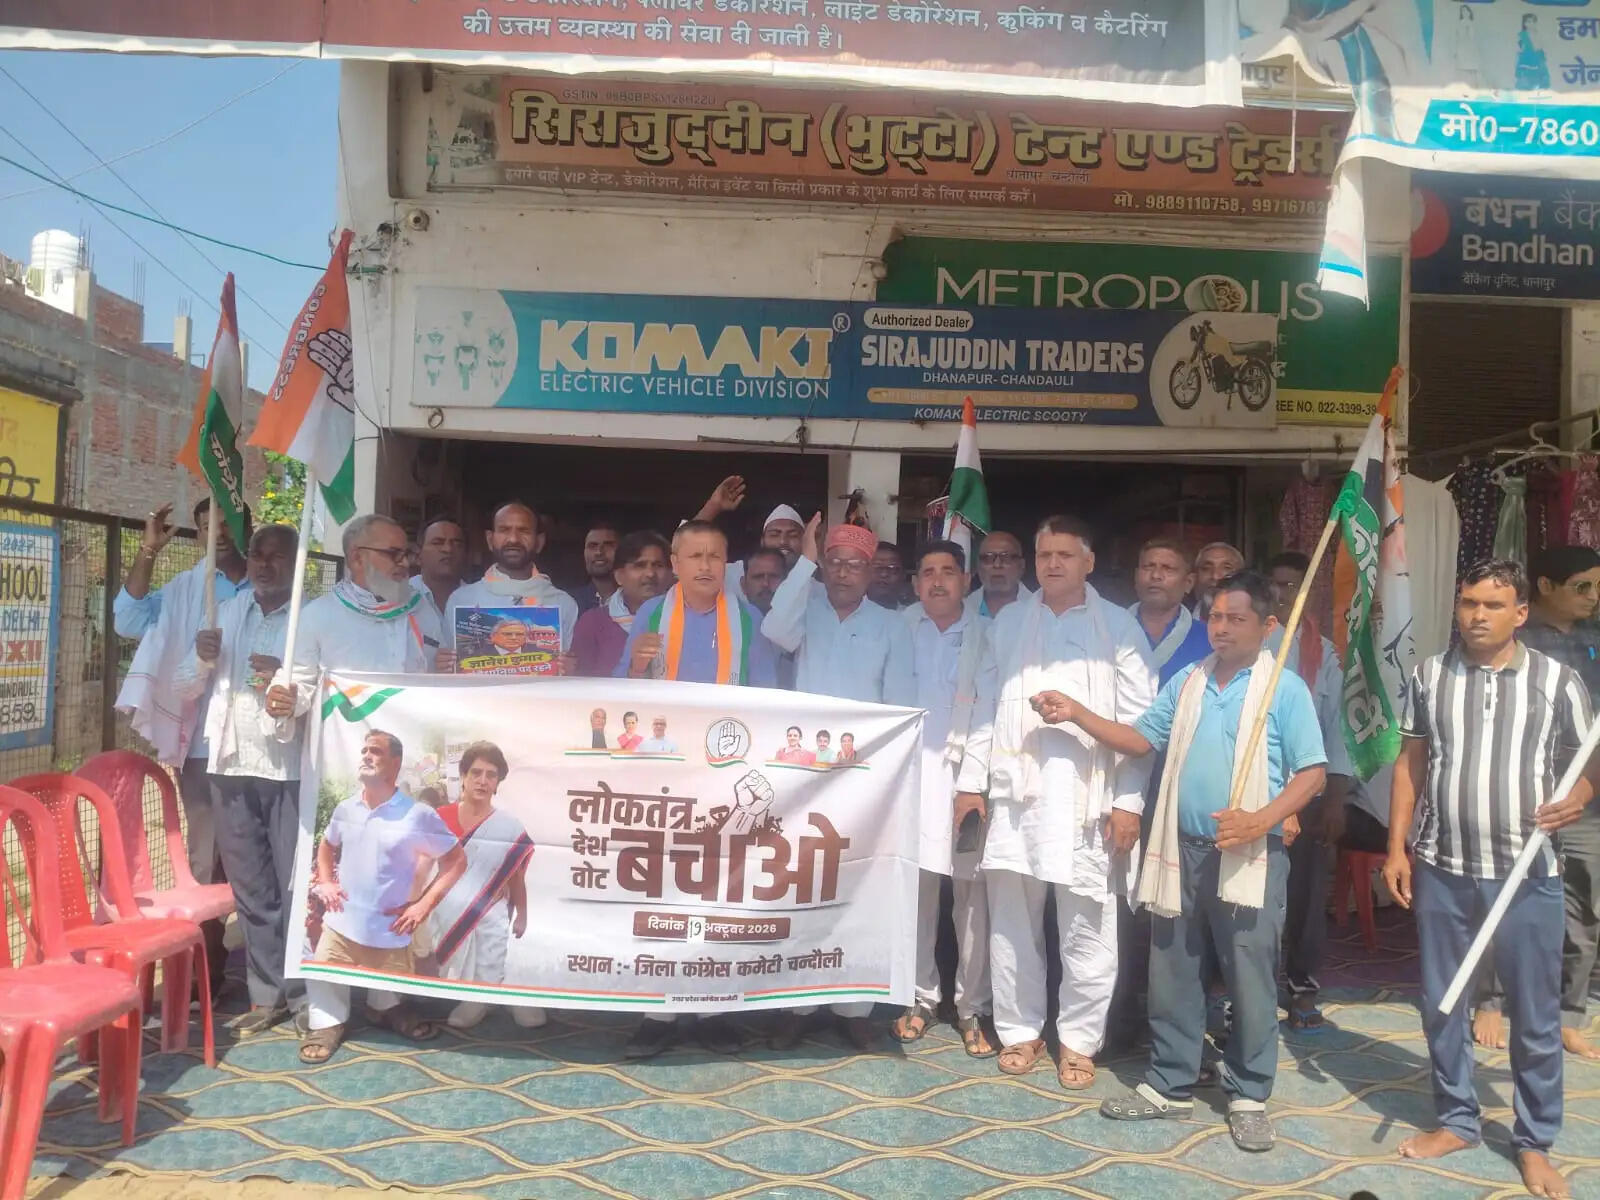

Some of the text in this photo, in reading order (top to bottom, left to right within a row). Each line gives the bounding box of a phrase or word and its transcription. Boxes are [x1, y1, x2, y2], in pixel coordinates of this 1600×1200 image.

[463, 9, 491, 34] की
[499, 16, 551, 36] उत्तम
[558, 18, 637, 40] व्यवस्था
[644, 16, 673, 41] की
[680, 18, 723, 44] सेवा
[730, 20, 751, 45] दी
[759, 23, 810, 47] जाती
[887, 1, 988, 31] डेकोरेशन,
[998, 8, 1063, 34] कुकिंग
[1070, 16, 1087, 33] व
[1094, 10, 1168, 38] कैटरिंग
[1556, 16, 1600, 40] हम
[1242, 64, 1287, 90] ापुर
[563, 172, 586, 184] VIP
[1463, 188, 1541, 229] बंधन
[1462, 233, 1594, 266] Bandhan
[937, 266, 1325, 321] METROPOLIS
[871, 312, 970, 329] Authorized Dealer
[538, 318, 834, 379] KOMAKI
[861, 334, 1145, 374] SIRAJUDDIN TRADERS
[539, 373, 831, 400] ELECTRIC VEHICLE DIVISION
[1000, 373, 1074, 386] CHANDAULI
[1033, 411, 1088, 422] SCOOTY
[1275, 400, 1377, 416] REE NO. 022-3399-39
[0, 562, 46, 601] HOOL
[3, 609, 41, 632] DELHI
[567, 781, 697, 830] लोकतंत्र
[571, 828, 610, 857] देश
[611, 812, 850, 904] बचाओ
[570, 861, 610, 890] वोट
[647, 915, 684, 931] दिनांक
[567, 953, 614, 975] स्थान
[633, 954, 677, 978] जिला
[681, 956, 731, 978] कांग्रेस
[736, 954, 783, 977] कमेटी
[786, 946, 844, 972] चन्दौली
